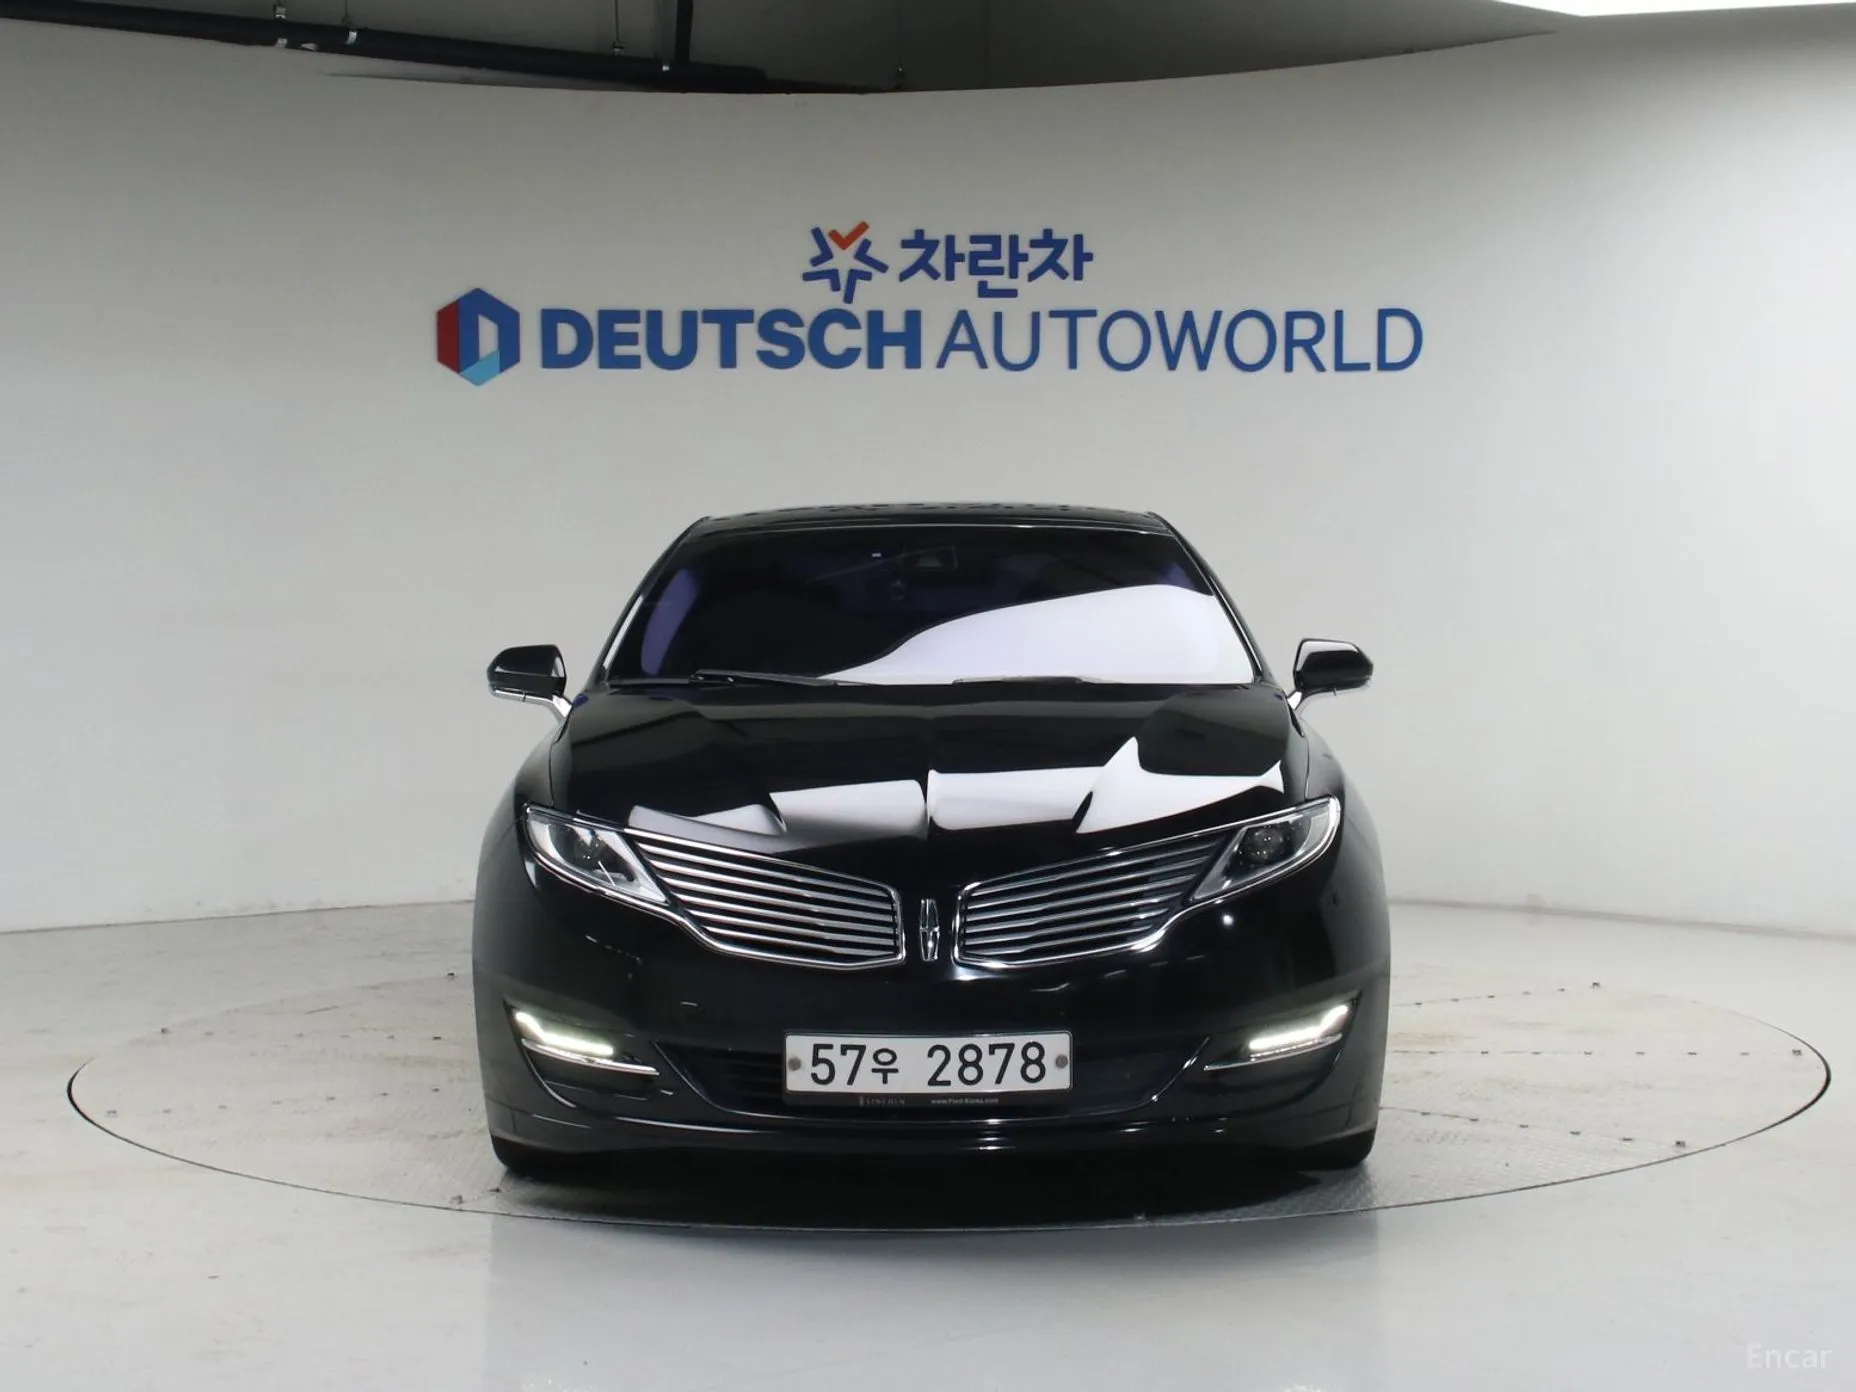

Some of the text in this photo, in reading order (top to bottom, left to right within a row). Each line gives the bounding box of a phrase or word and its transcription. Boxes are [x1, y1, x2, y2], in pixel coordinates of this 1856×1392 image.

[900, 229, 1093, 299] 차란차
[541, 307, 1425, 373] DEUTSCH AUTOWORLD
[810, 1041, 1046, 1086] 57우 2878
